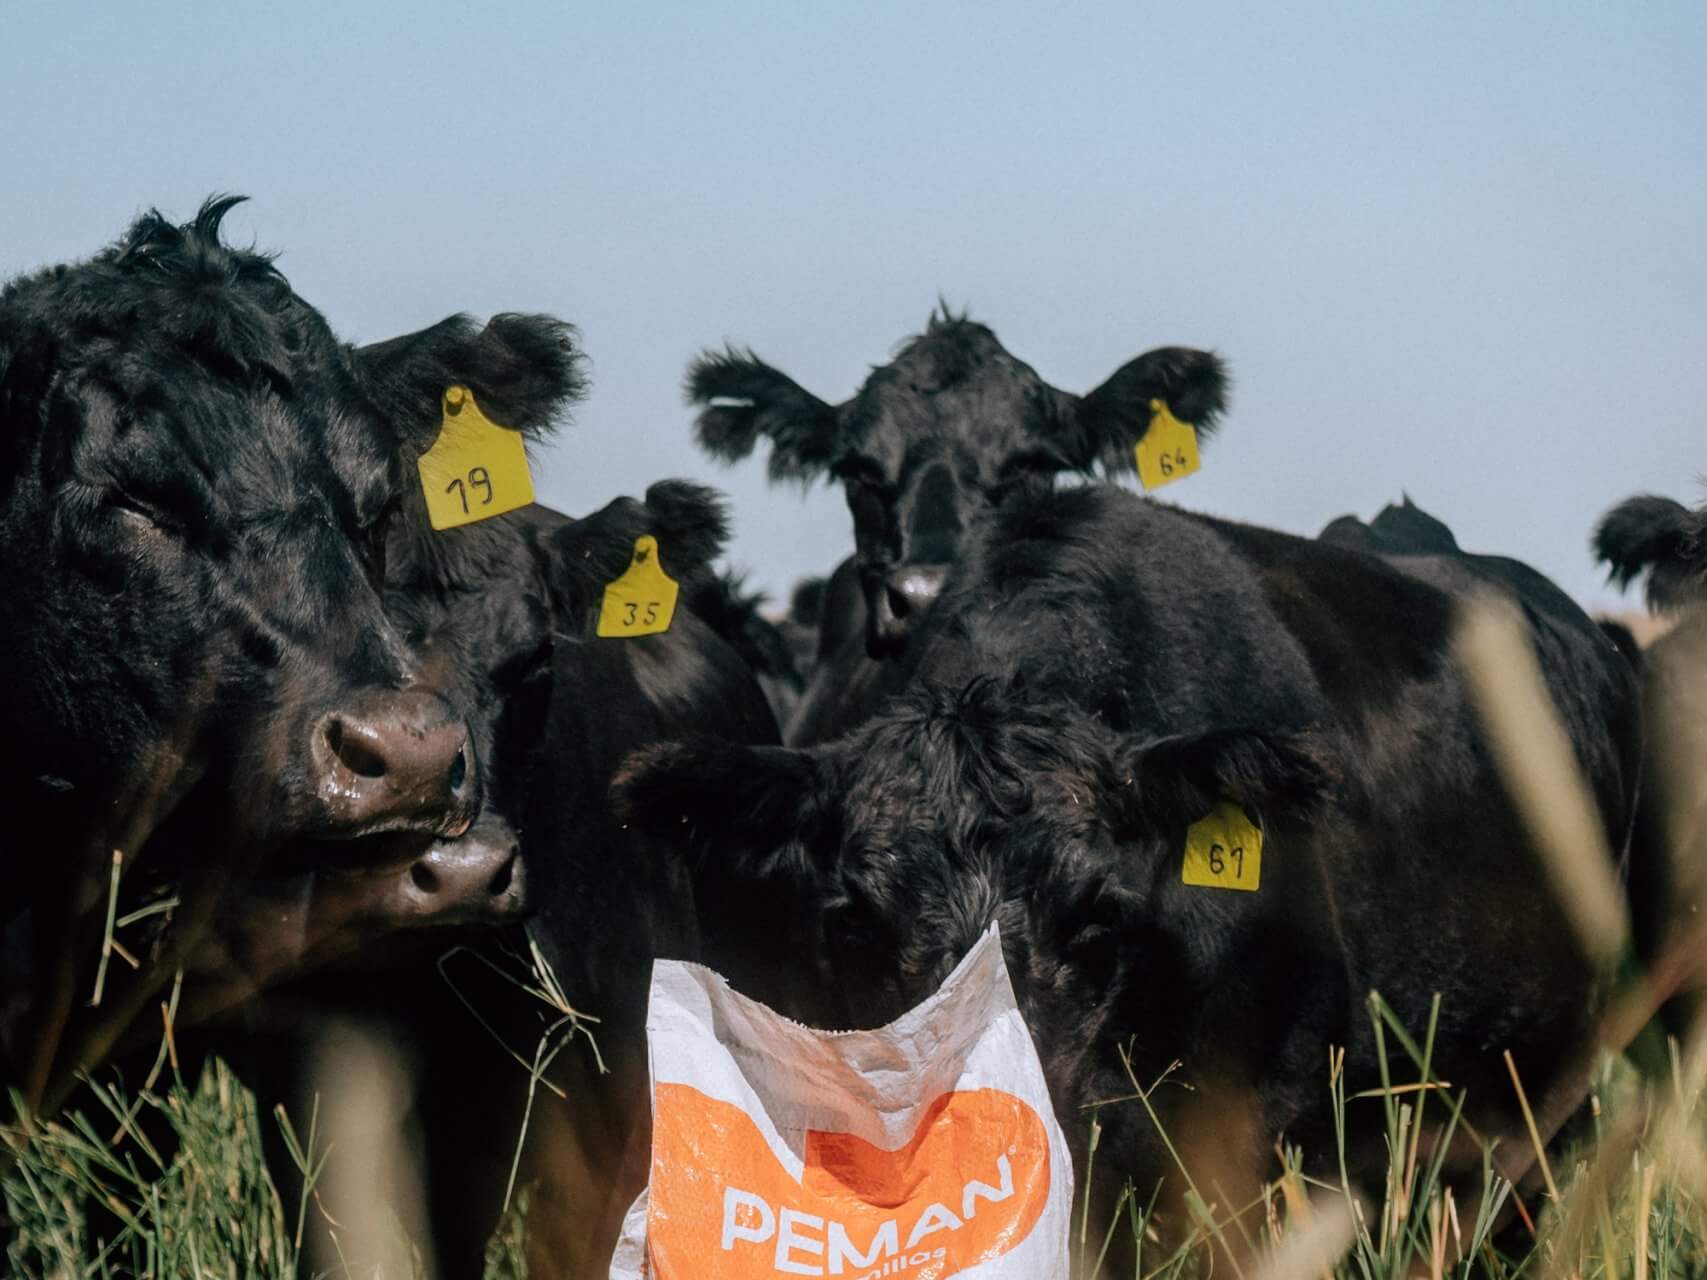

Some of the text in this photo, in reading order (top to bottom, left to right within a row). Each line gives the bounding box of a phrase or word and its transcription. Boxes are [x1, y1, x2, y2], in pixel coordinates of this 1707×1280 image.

[1160, 449, 1186, 477] 64
[623, 602, 661, 627] 35
[721, 1153, 1015, 1277] PEMAN
